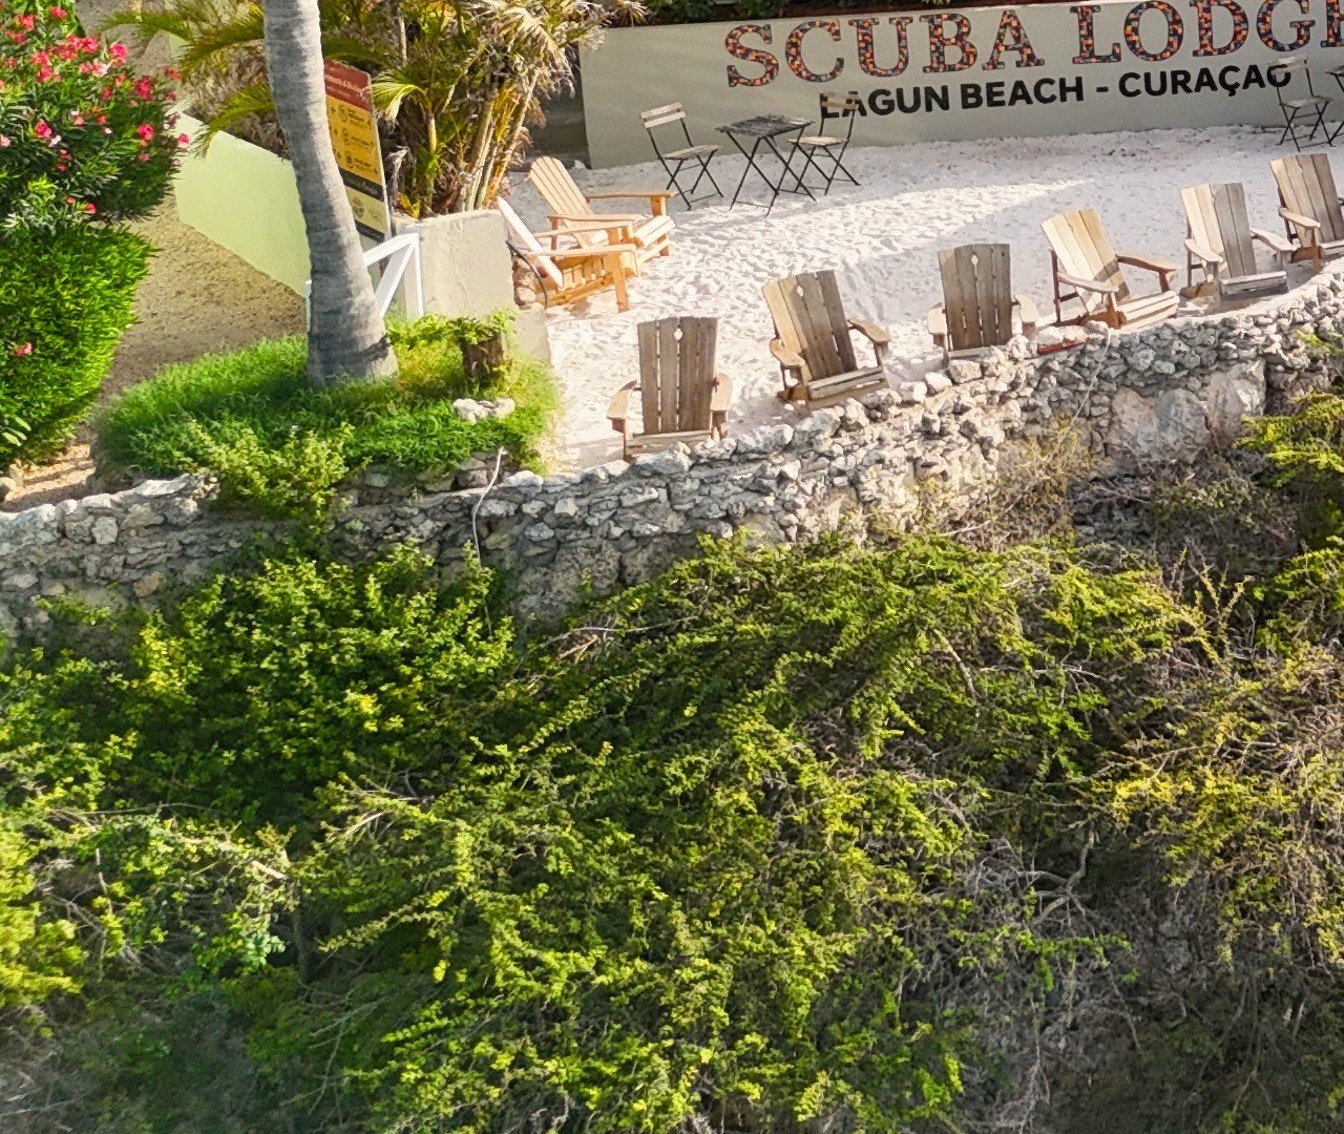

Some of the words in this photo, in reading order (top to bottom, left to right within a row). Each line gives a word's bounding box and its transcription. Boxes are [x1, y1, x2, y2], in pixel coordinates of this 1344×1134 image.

[724, 10, 1045, 87] SCUBA
[819, 84, 950, 118] LAGUN
[960, 76, 1084, 109] BEACH
[1096, 85, 1109, 93] -
[1118, 64, 1291, 97] CURAÇAO
